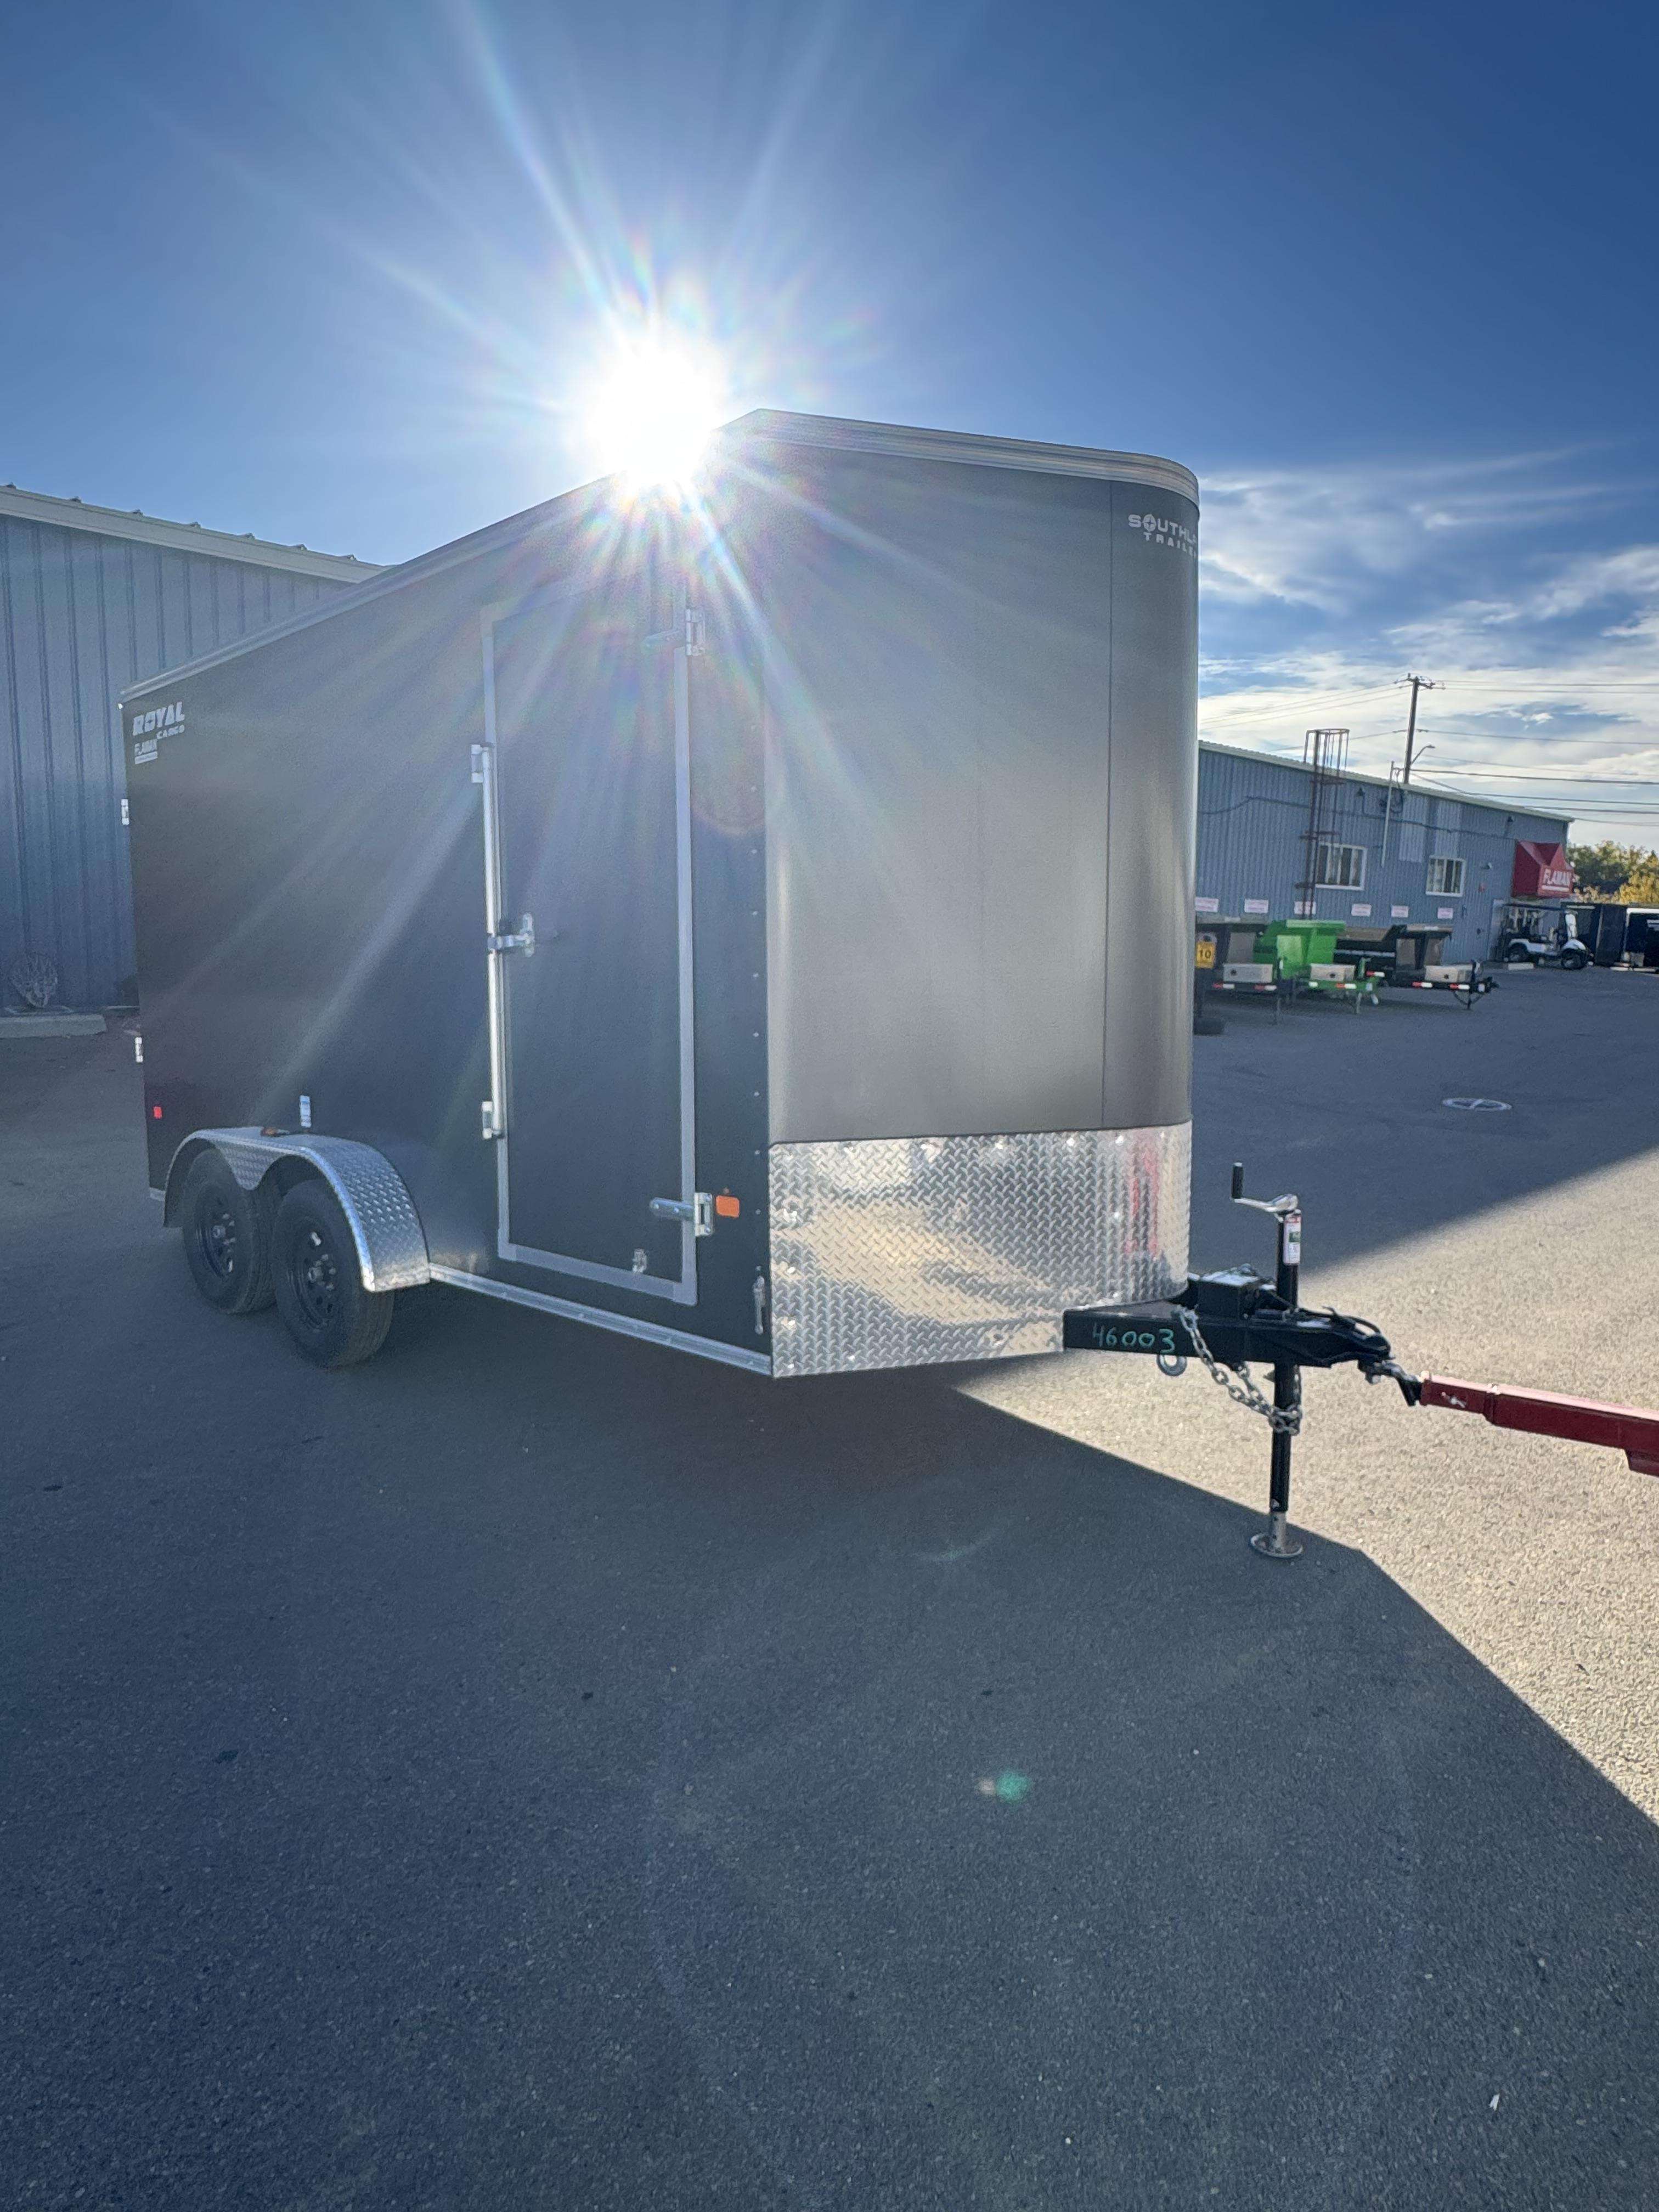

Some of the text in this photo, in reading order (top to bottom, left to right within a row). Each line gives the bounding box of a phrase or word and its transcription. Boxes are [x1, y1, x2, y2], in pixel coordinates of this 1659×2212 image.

[133, 702, 185, 736] ROYAL
[1198, 949, 1211, 959] 10
[1093, 1322, 1175, 1353] 46003
